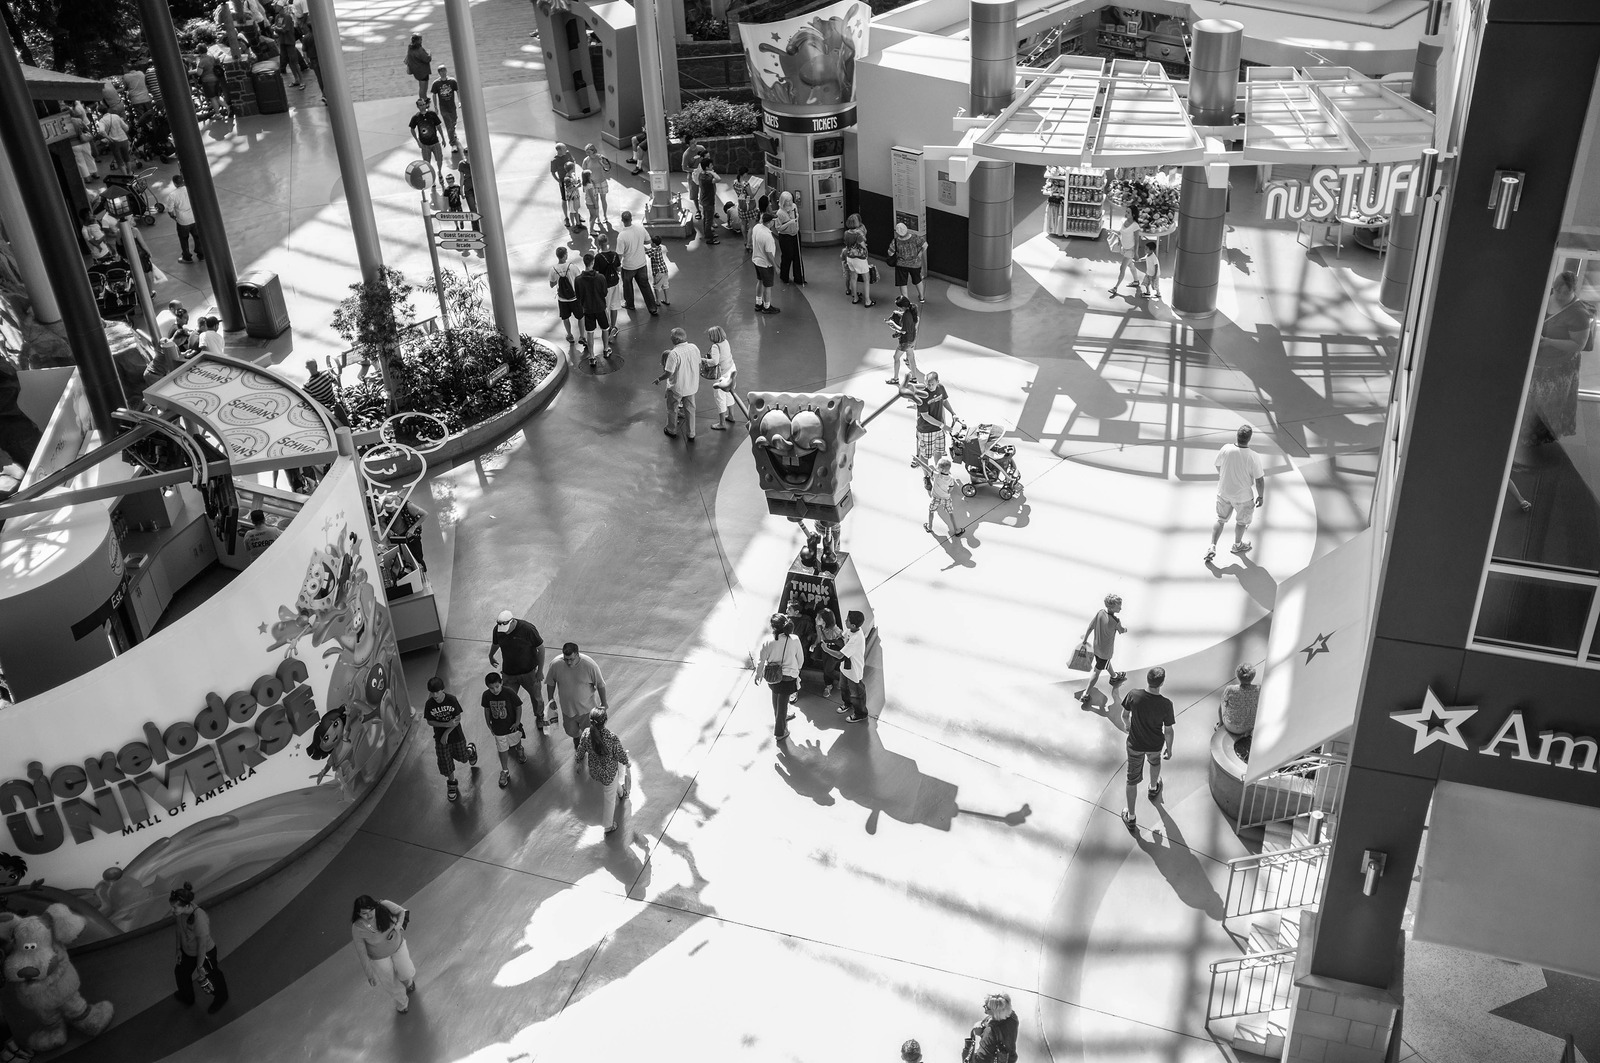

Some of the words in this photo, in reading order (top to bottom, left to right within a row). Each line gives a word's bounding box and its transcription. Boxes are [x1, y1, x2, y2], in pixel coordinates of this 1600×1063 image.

[812, 116, 838, 132] TICKETS
[789, 590, 831, 606] HAPPY
[791, 580, 830, 596] THINK
[0, 657, 310, 816] nickelodeon
[6, 683, 321, 856] UNIVERSE
[121, 814, 162, 837] MALL
[168, 802, 188, 817] OF
[194, 767, 257, 806] AMERICA
